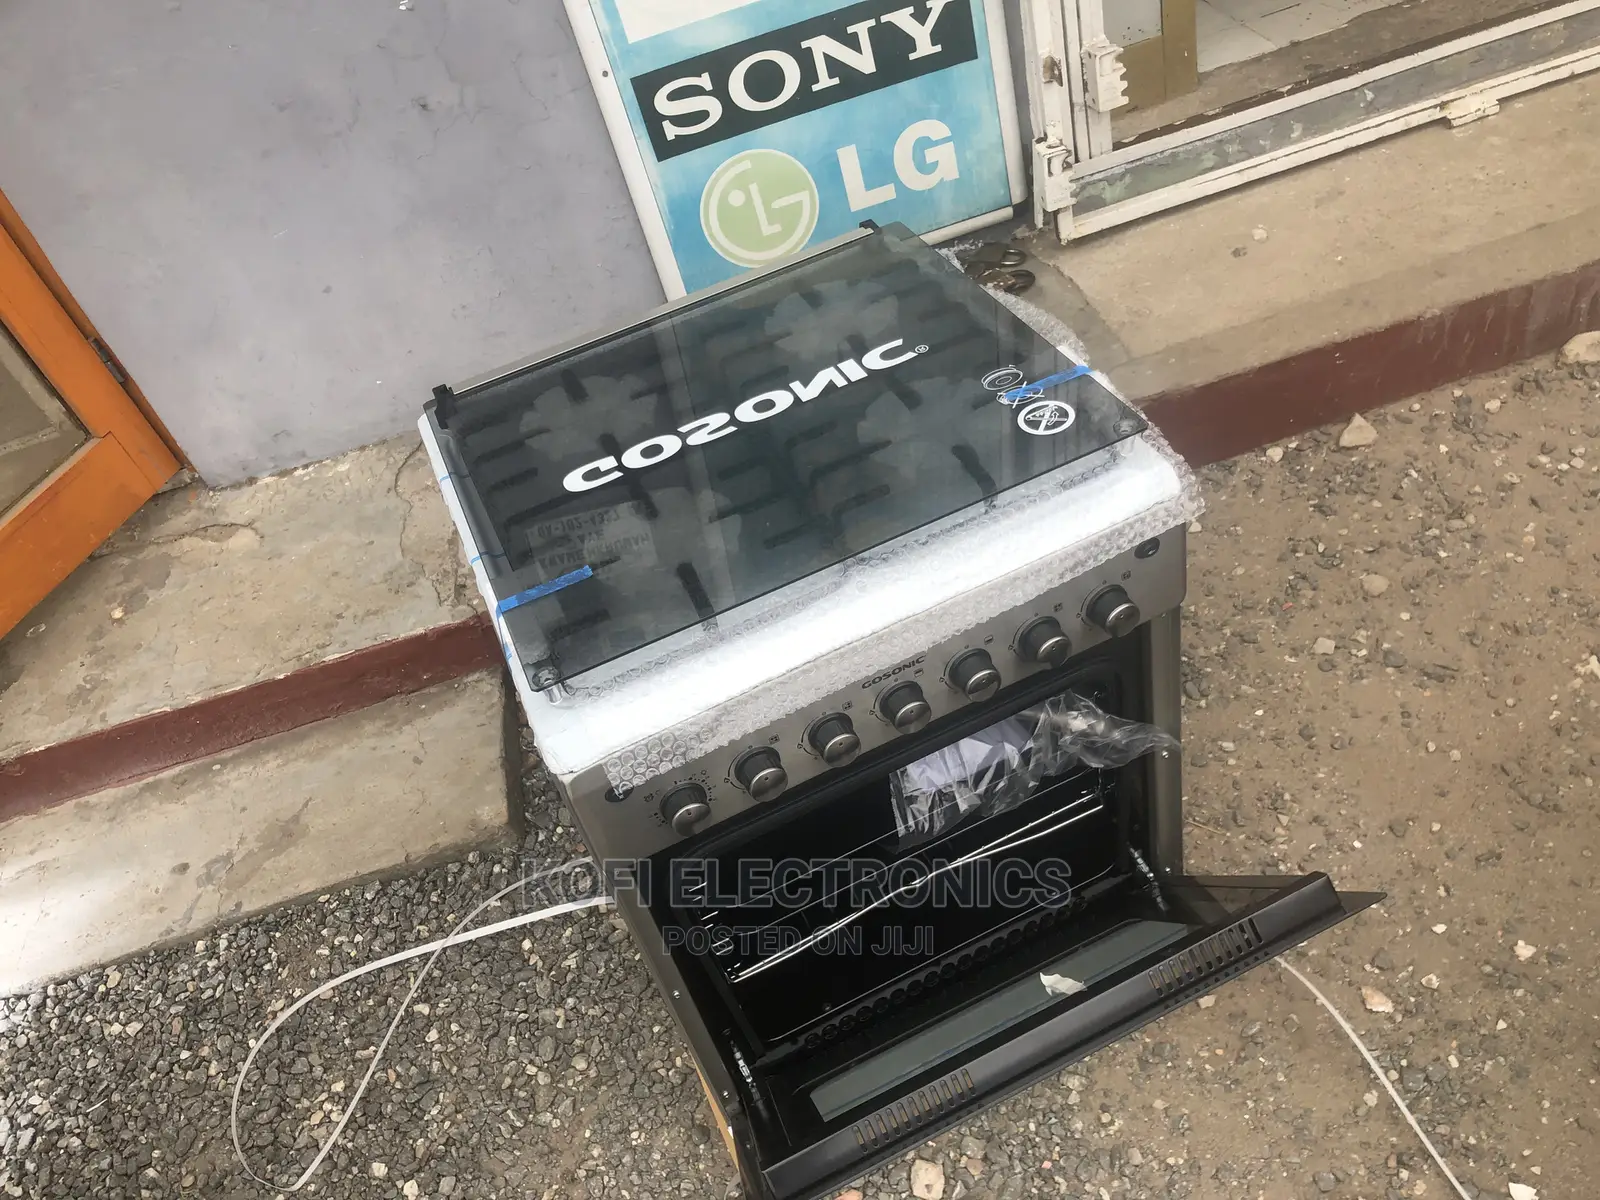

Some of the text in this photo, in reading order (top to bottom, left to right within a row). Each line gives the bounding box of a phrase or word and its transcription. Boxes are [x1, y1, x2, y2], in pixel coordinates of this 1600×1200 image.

[653, 0, 955, 141] SONY
[837, 119, 960, 212] LG
[862, 655, 926, 689] GOSONIC
